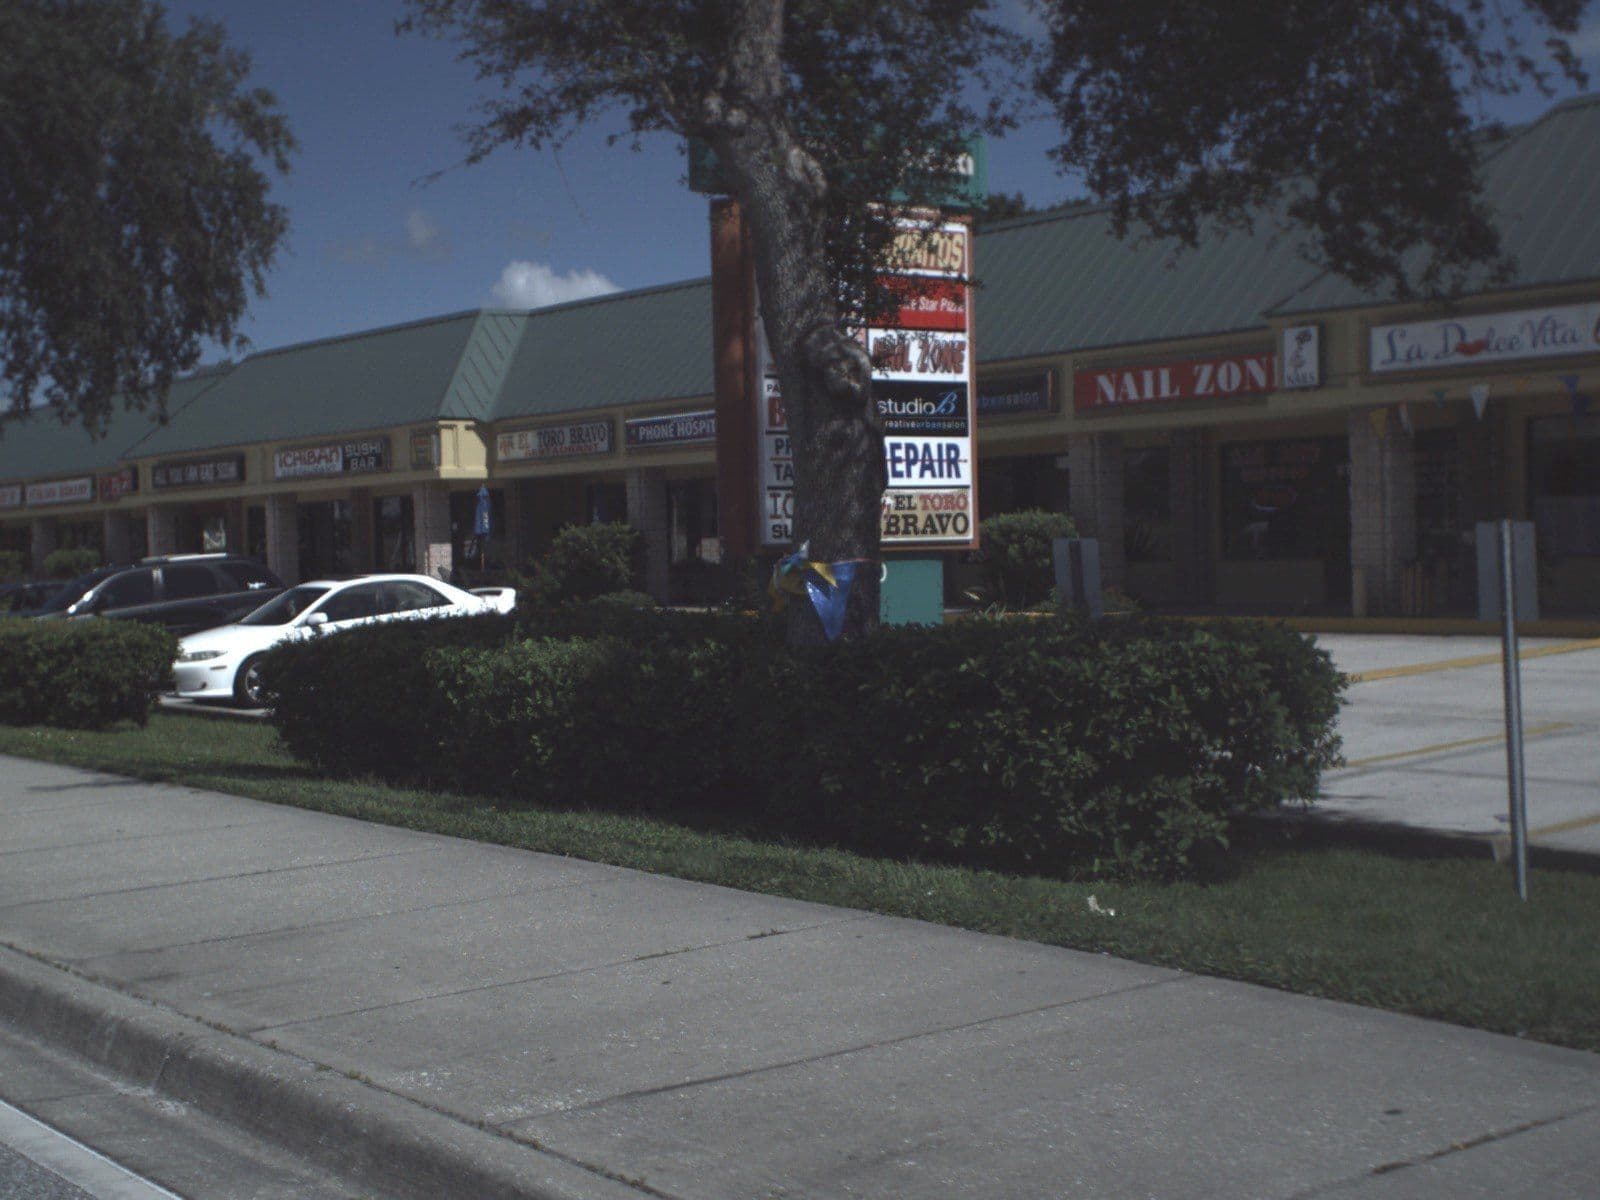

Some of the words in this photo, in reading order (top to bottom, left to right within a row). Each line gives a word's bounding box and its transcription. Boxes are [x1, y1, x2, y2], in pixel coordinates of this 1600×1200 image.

[1380, 326, 1427, 365] La
[1521, 313, 1582, 350] Vita
[917, 338, 966, 375] ZONE
[1094, 368, 1181, 405] NAIL
[1193, 355, 1279, 396] ZON
[536, 429, 565, 448] TORO
[569, 423, 607, 444] BRAVO
[638, 421, 675, 441] PHONE
[344, 440, 382, 457] SUSHI
[885, 441, 962, 480] EPAIR
[350, 456, 377, 471] BAR
[894, 494, 917, 511] EL
[919, 493, 968, 511] TORO
[883, 512, 969, 536] BRAVO
